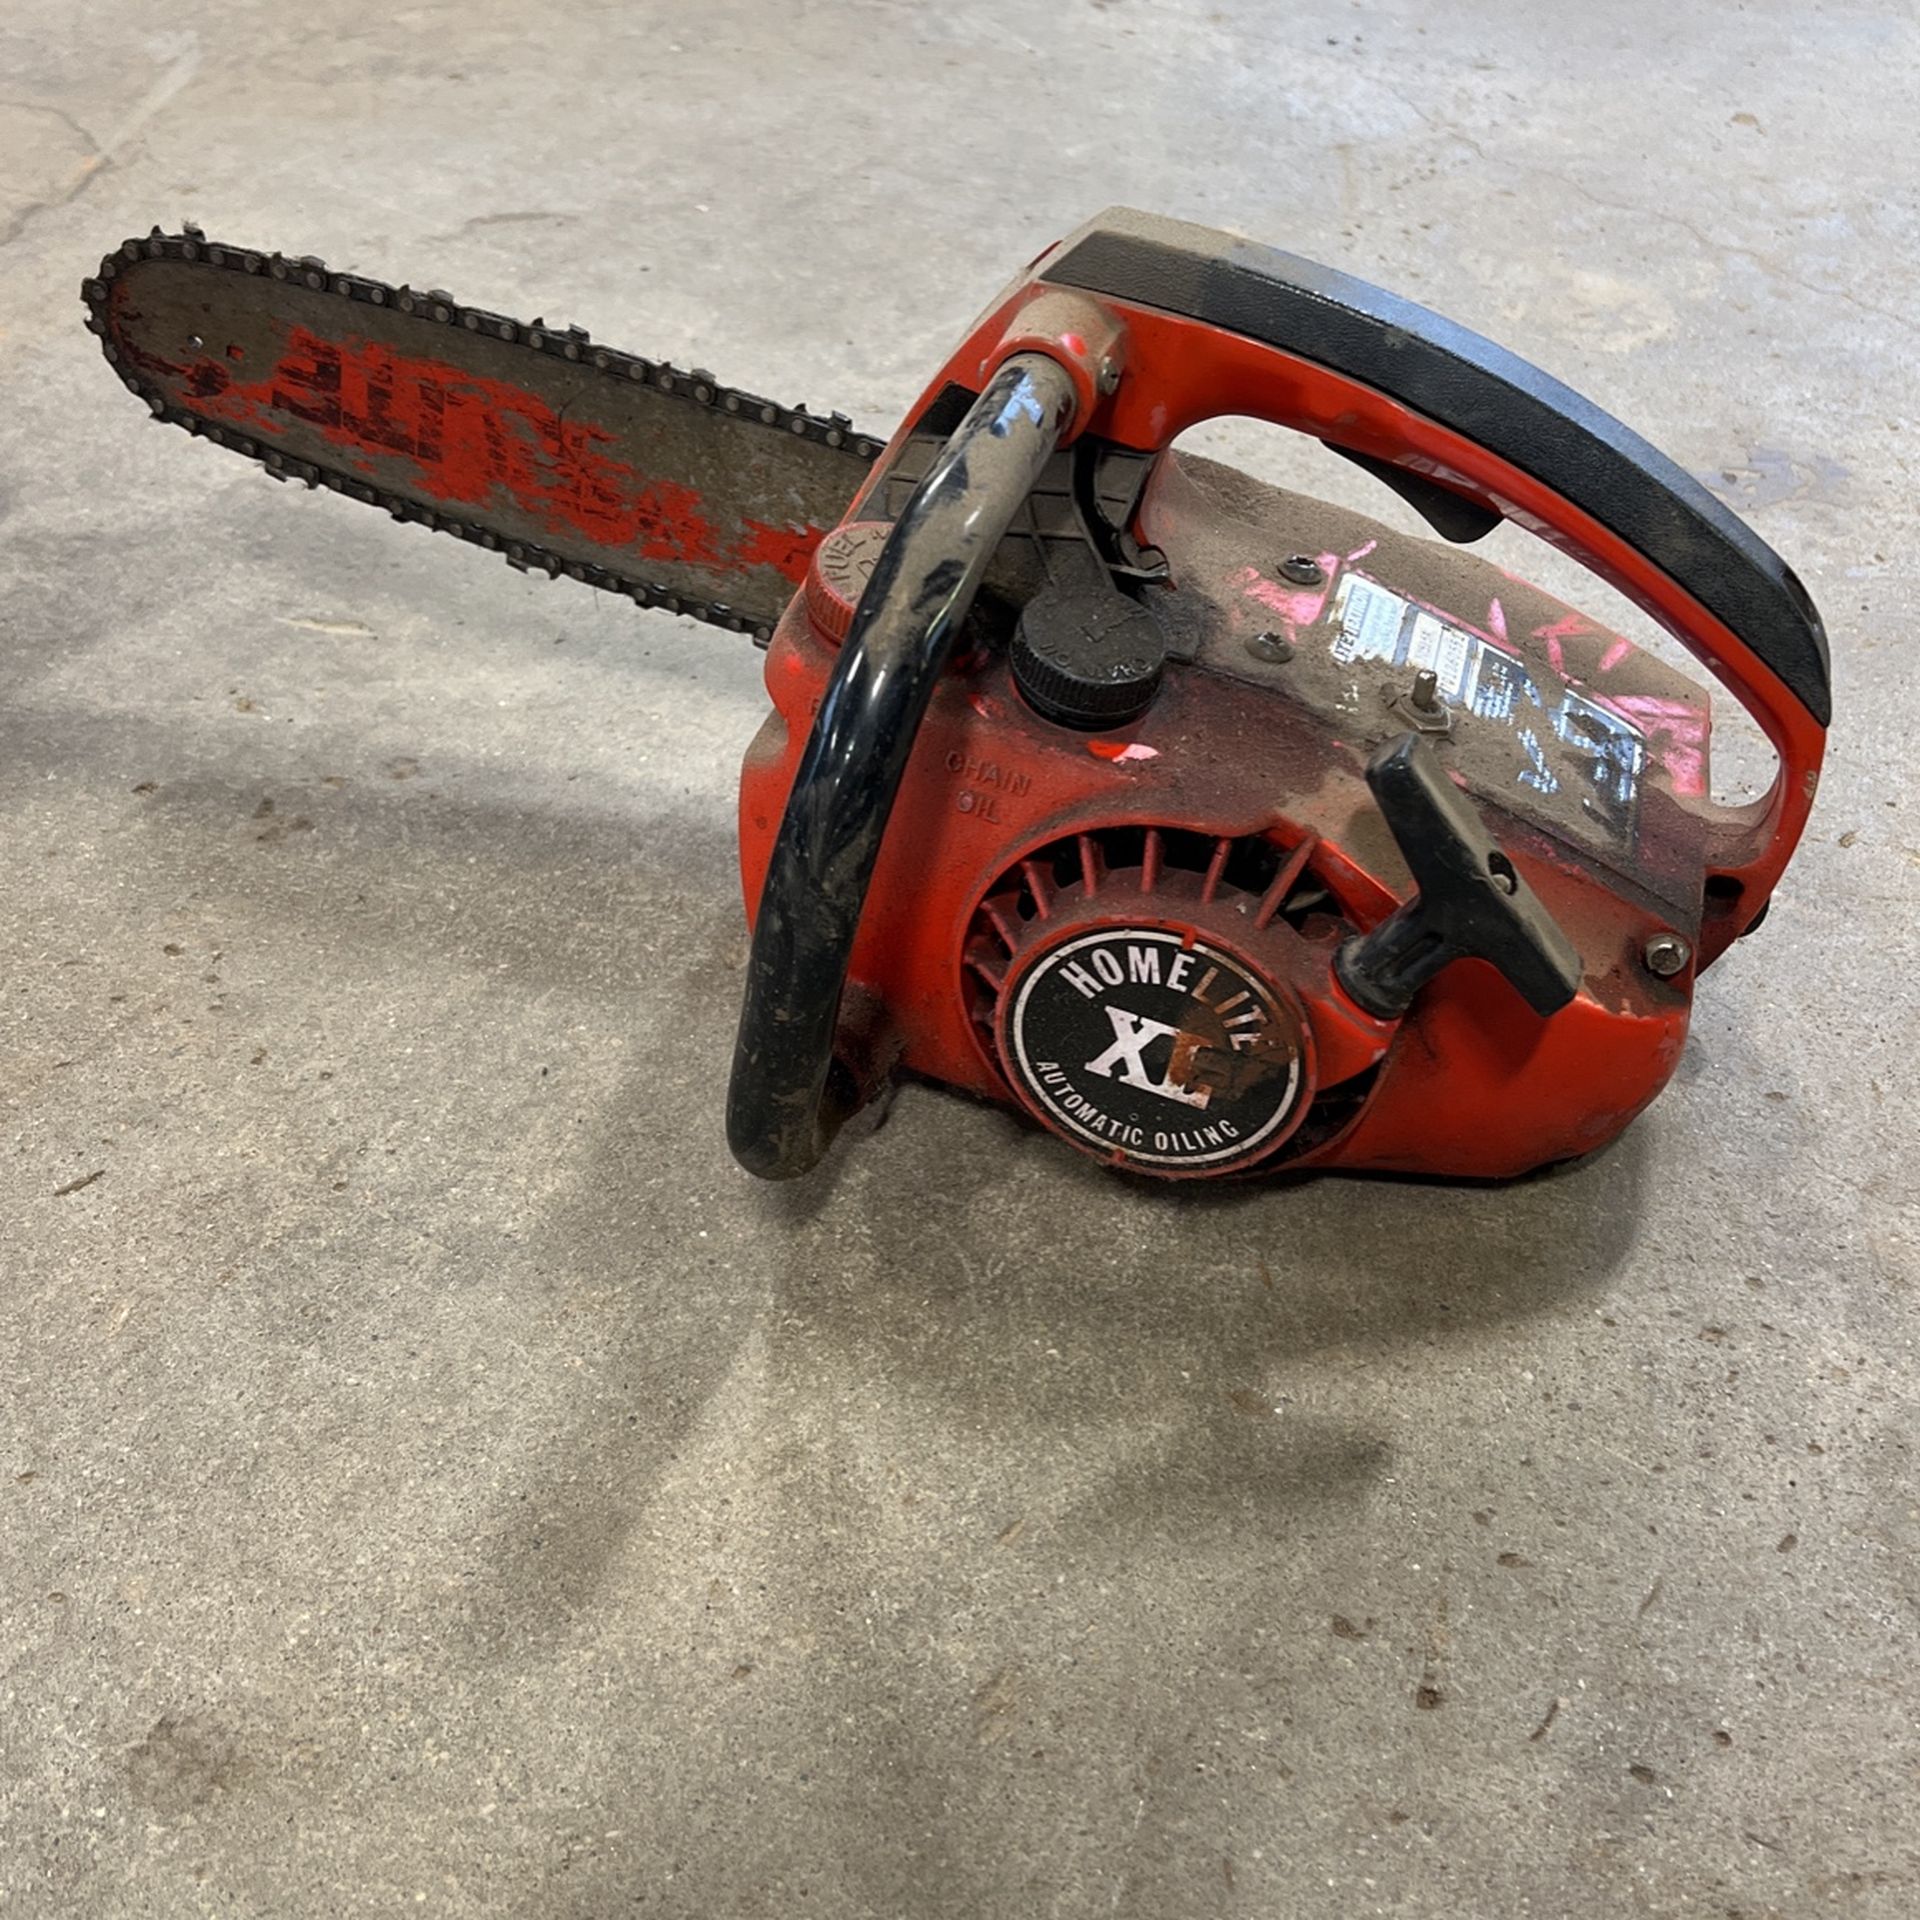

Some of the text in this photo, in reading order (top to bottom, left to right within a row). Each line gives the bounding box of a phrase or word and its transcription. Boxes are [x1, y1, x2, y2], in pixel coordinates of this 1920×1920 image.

[824, 532, 868, 583] FUEL
[946, 750, 1031, 797] CHAIN
[957, 790, 1000, 825] OIL
[1036, 1061, 1240, 1151] AUTOMATIC OILING
